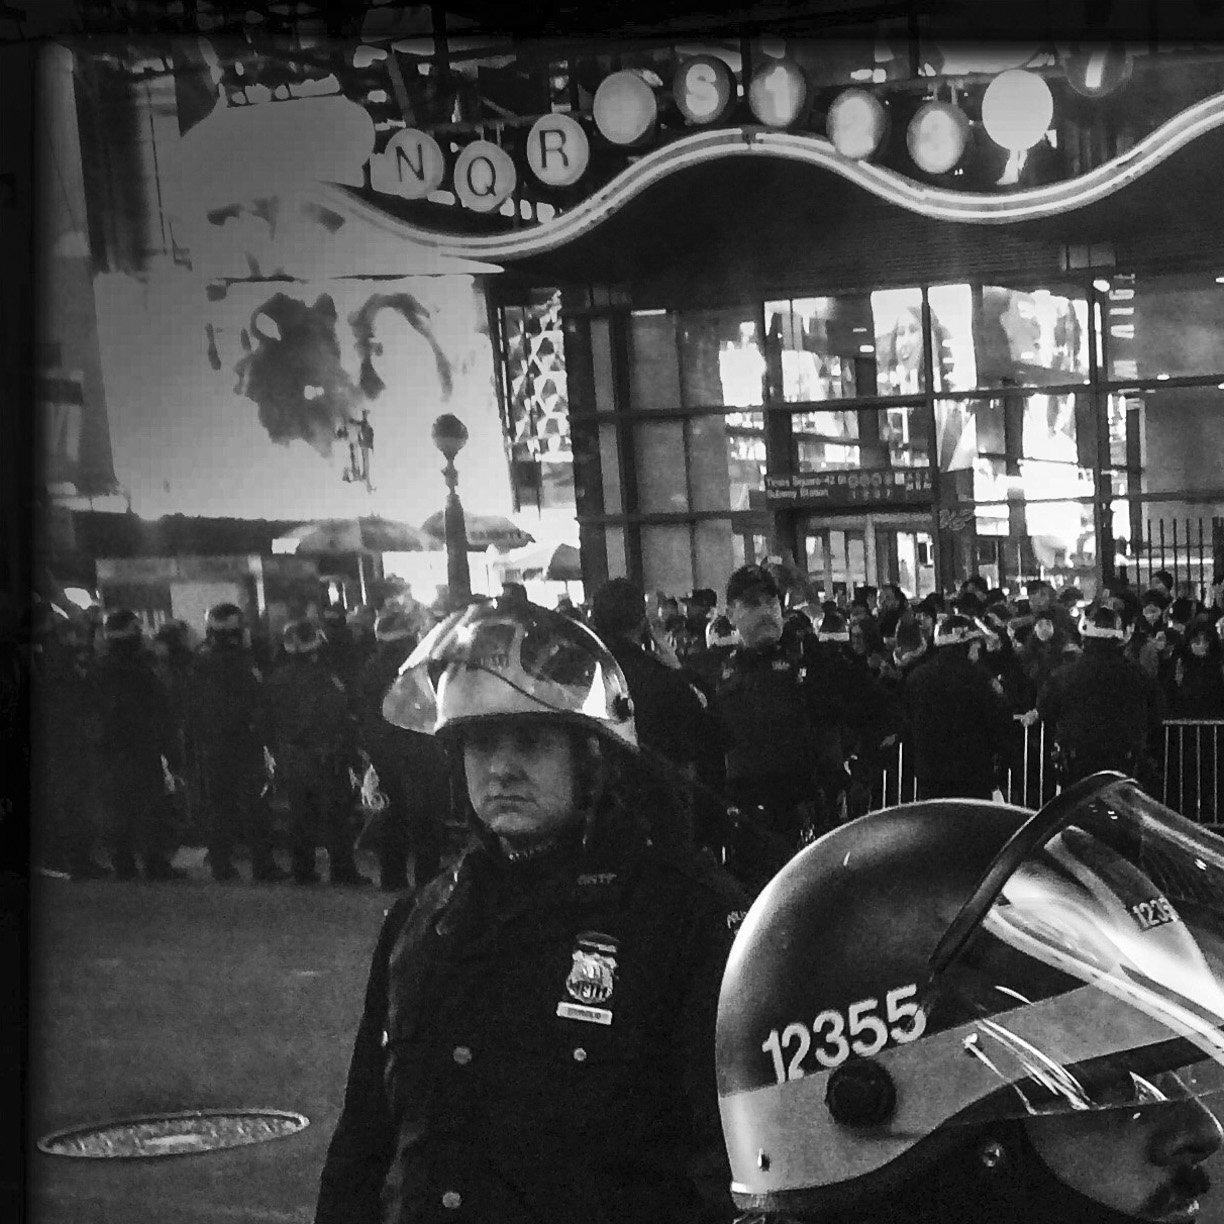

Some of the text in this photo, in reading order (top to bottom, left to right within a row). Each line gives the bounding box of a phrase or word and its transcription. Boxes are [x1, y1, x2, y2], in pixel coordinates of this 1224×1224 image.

[395, 143, 425, 183] N
[466, 155, 497, 198] Q
[538, 128, 570, 170] R
[685, 63, 720, 116] S
[765, 66, 792, 119] 1
[761, 982, 927, 1085] 12355
